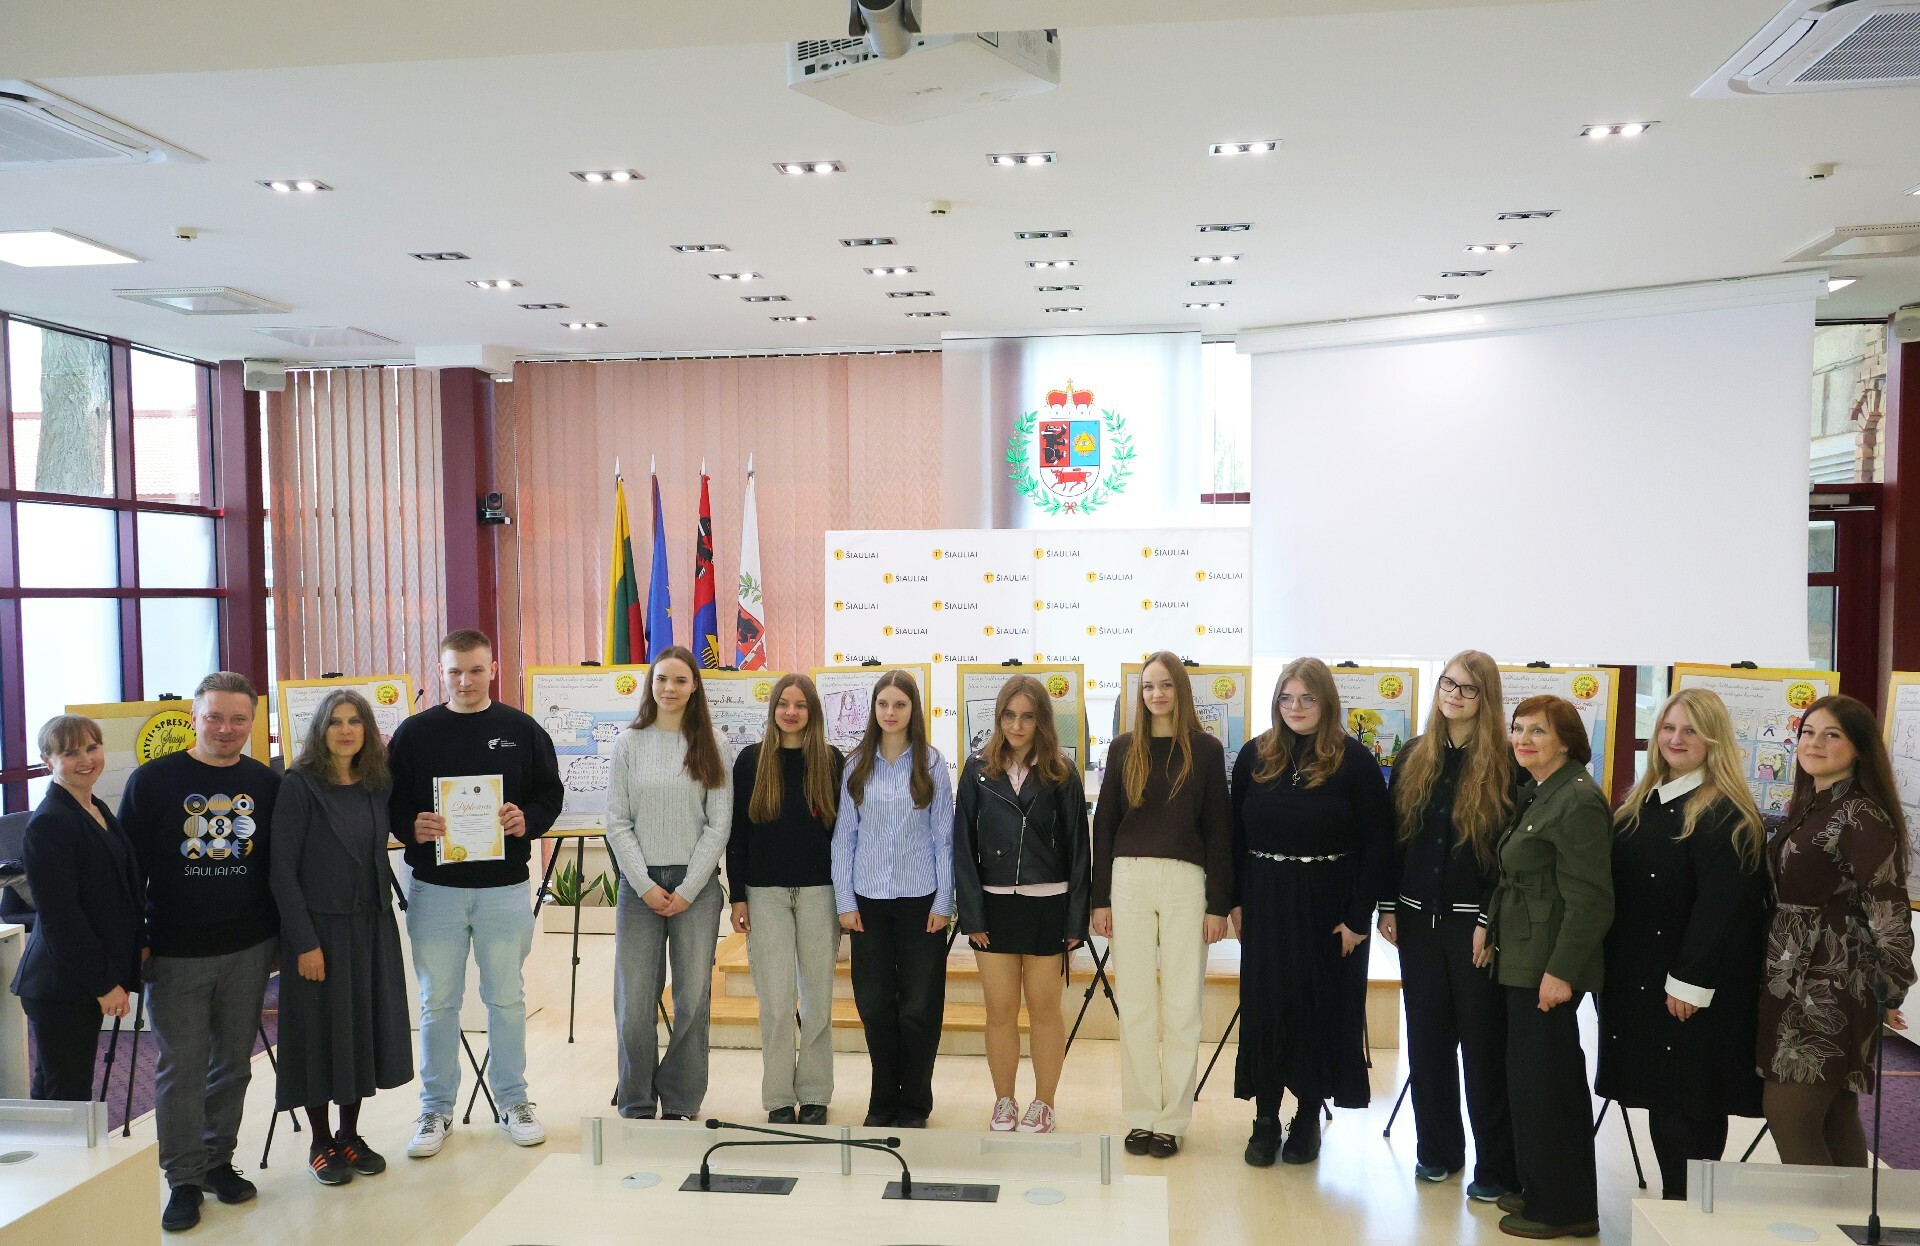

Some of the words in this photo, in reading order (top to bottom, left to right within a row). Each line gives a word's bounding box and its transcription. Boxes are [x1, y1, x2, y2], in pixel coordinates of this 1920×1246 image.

[845, 551, 879, 559] ŠIAULIAI
[944, 550, 978, 558] ŠIAULIAI
[1046, 550, 1080, 558] ŠIAULIAI
[1154, 549, 1189, 557] ŠIAULIAI
[895, 574, 928, 582] ŠIAULIAI
[996, 573, 1030, 582] ŠIAULIAI
[1099, 573, 1133, 581] ŠIAULIAI
[1208, 572, 1243, 580] ŠIAULIAI
[845, 602, 879, 610] ŠIAULIAI
[944, 602, 978, 610] ŠIAULIAI
[1046, 601, 1080, 609] ŠIAULIAI
[895, 627, 928, 635] ŠIAULIAI
[996, 627, 1030, 635] ŠIAULIAI
[1099, 627, 1133, 635] ŠIAULIAI
[1208, 626, 1243, 634] ŠIAULIAI
[944, 654, 978, 662] ŠIAULIAI
[1046, 654, 1080, 662] ŠIAULIAI
[1098, 681, 1121, 689] ŠIAUL
[143, 732, 155, 760] ATYTI
[184, 864, 228, 876] ŠIAULIAI
